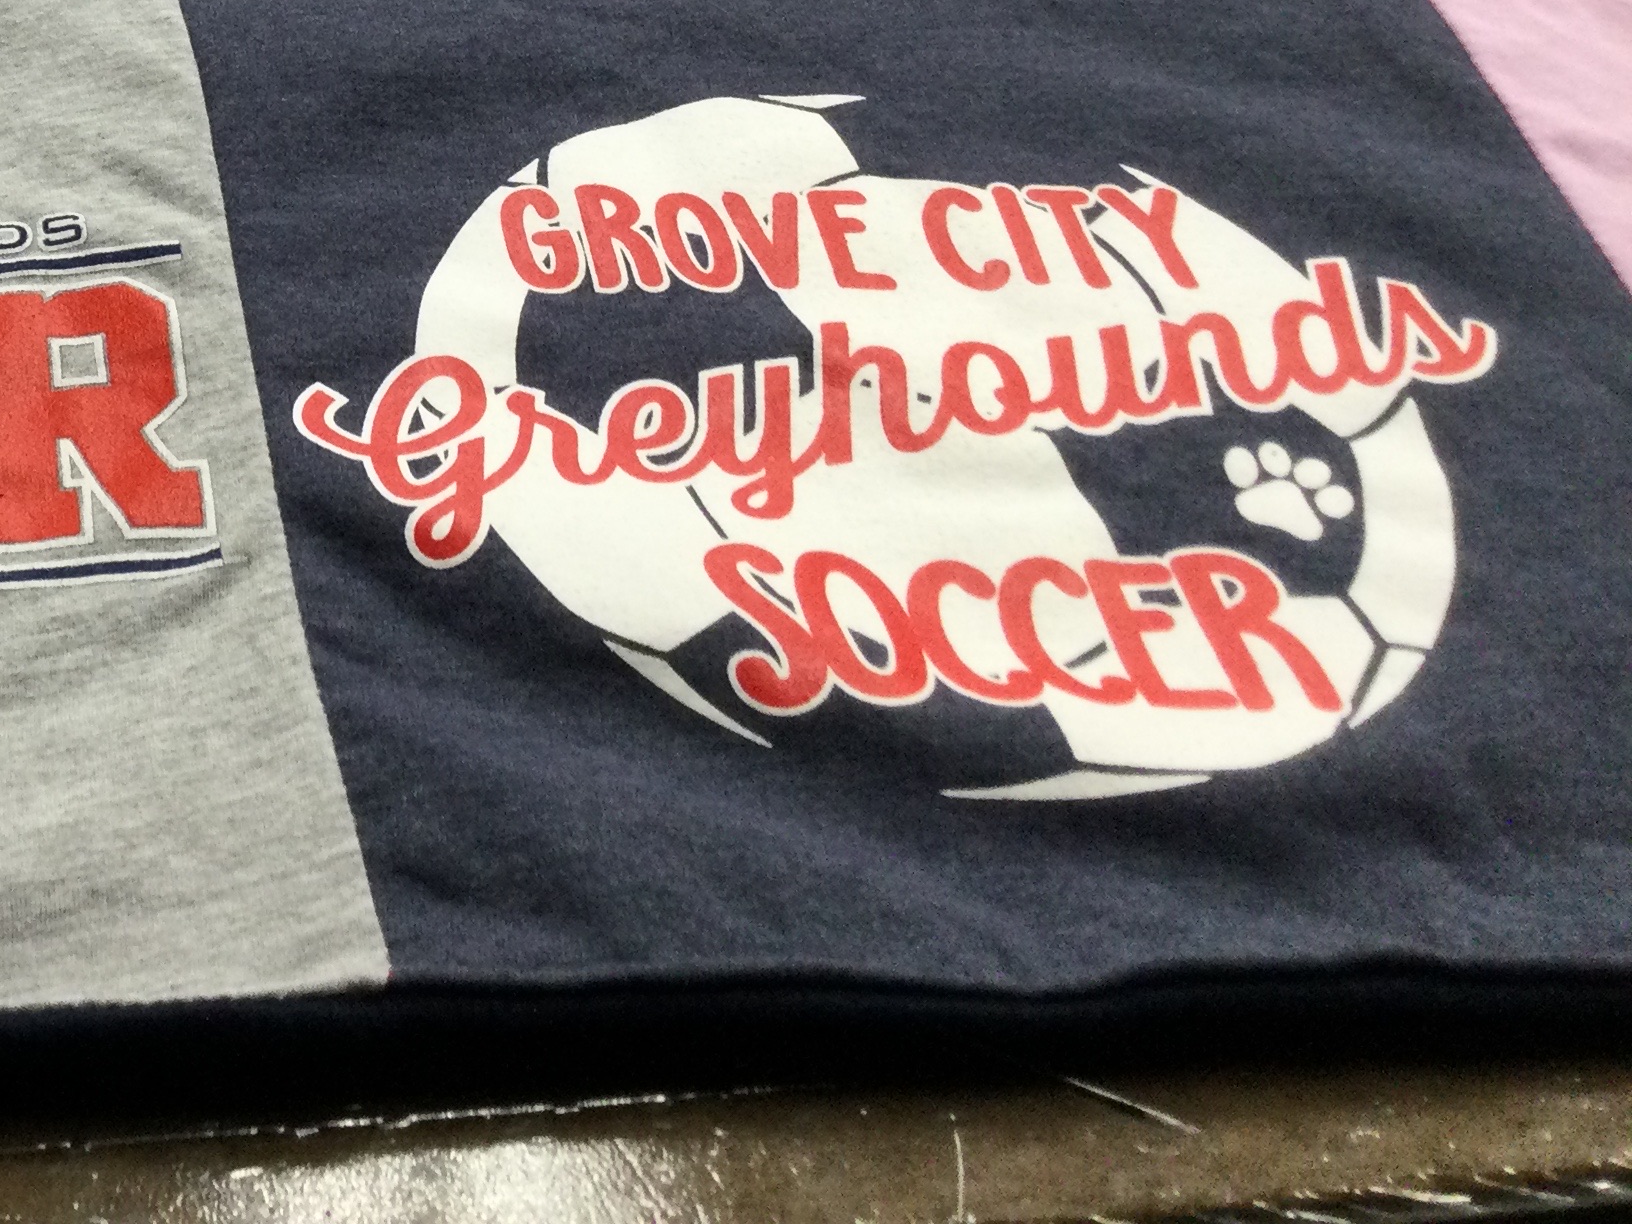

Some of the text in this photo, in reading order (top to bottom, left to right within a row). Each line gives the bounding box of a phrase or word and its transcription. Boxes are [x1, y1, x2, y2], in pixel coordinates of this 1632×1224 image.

[497, 180, 1208, 296] GROVE CITY
[292, 256, 1498, 570] Greyhounds
[700, 541, 1345, 716] SOCCER
